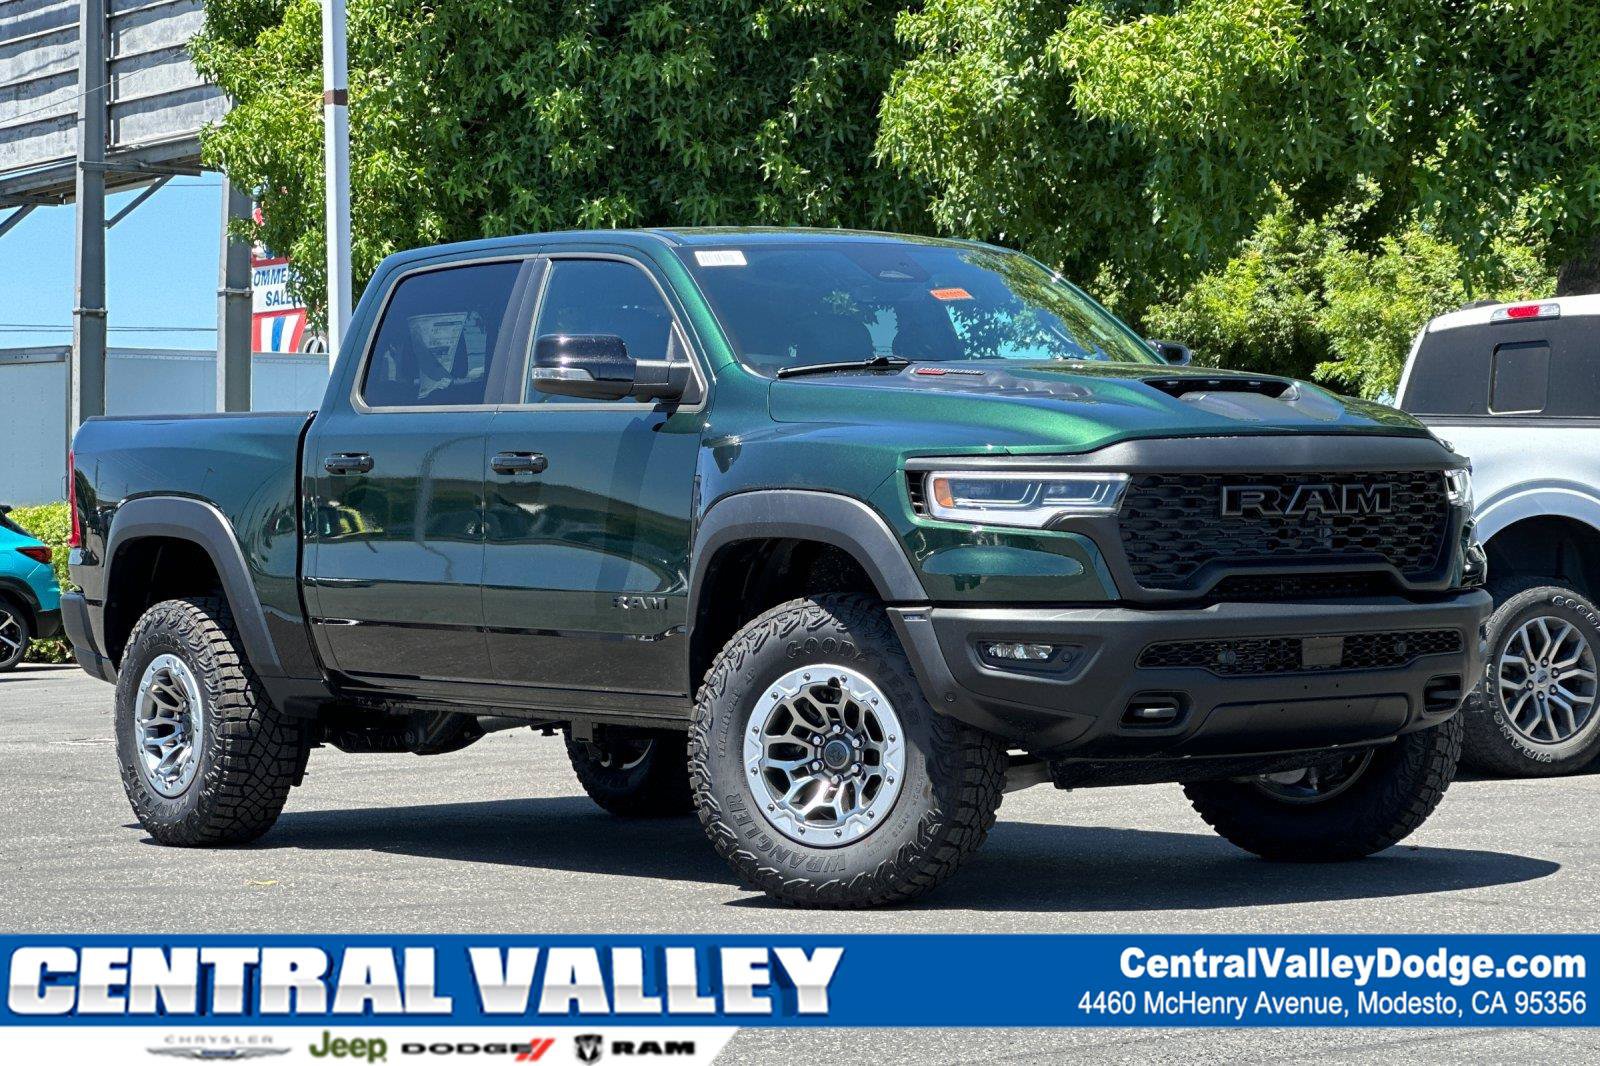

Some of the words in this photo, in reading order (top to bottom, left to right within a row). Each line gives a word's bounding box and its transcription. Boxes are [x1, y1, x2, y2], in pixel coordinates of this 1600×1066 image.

[1222, 484, 1392, 515] RAM
[613, 596, 668, 609] RAM
[726, 793, 848, 873] WRANGLER
